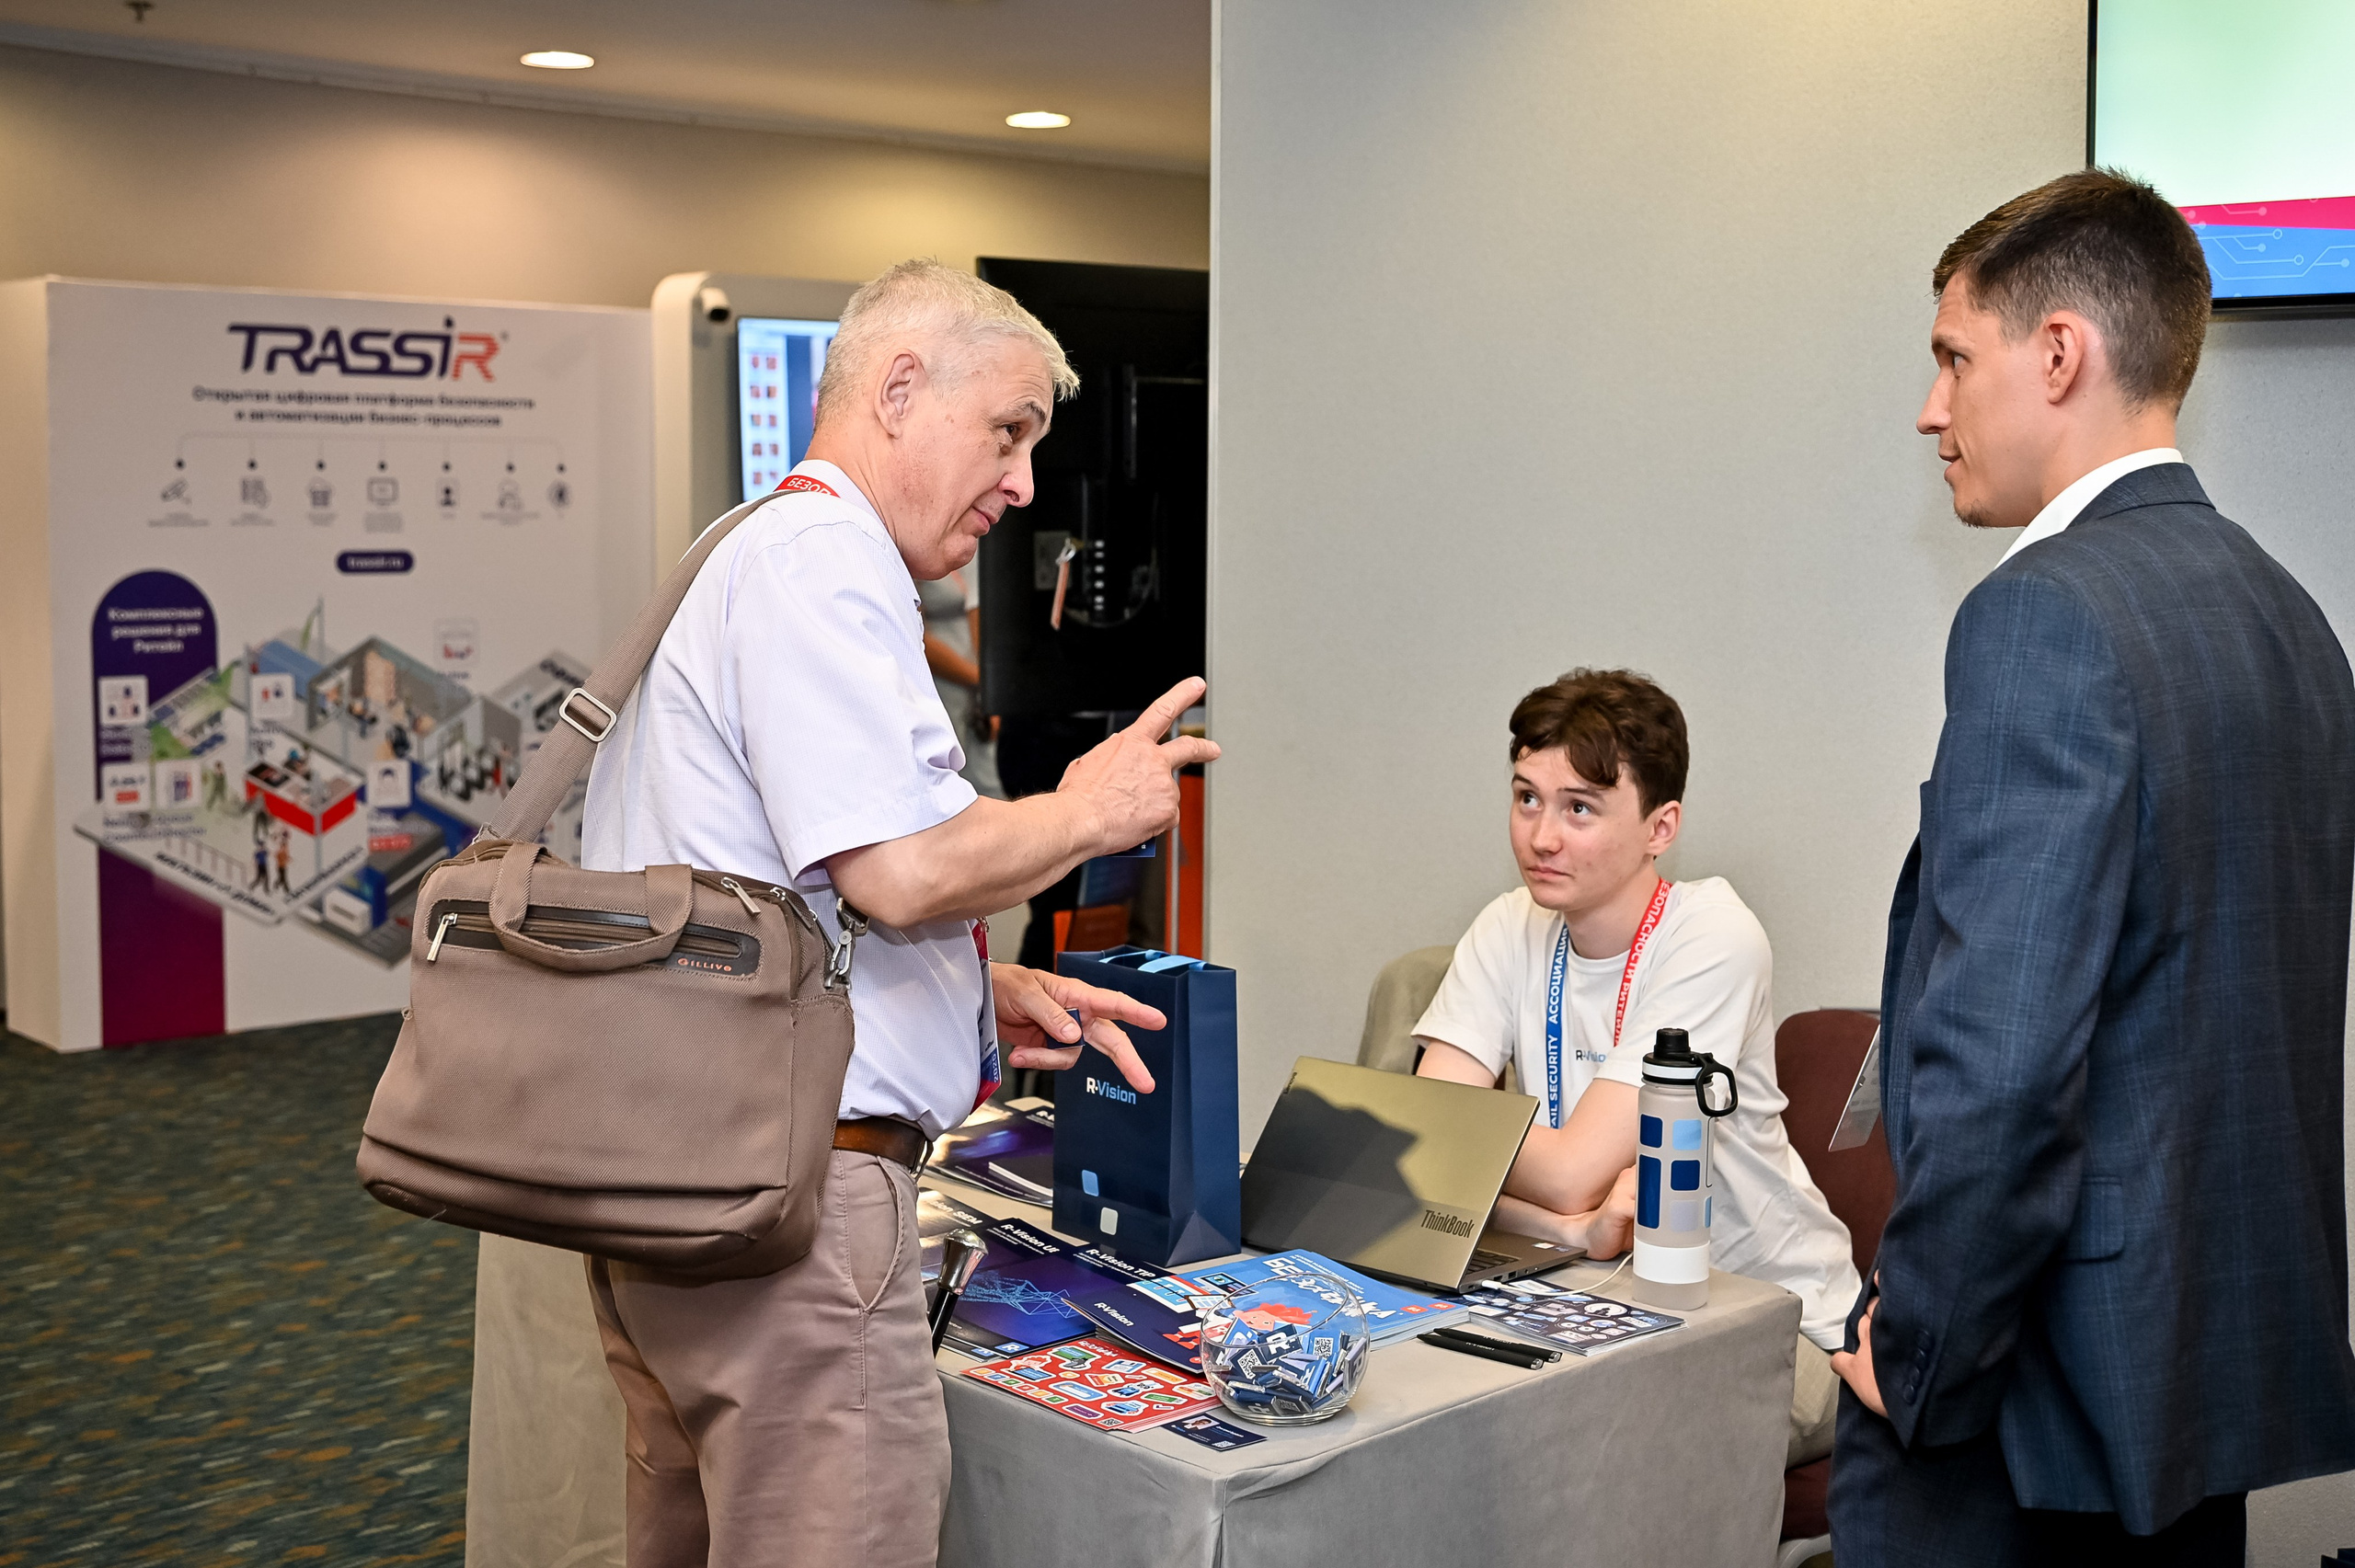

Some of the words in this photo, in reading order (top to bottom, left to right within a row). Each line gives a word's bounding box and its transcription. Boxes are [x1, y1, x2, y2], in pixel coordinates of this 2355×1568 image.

[1547, 1034, 1558, 1102] SECURITY
[953, 1210, 983, 1225] SIEM
[1421, 1209, 1475, 1239] ThinkBook
[1000, 1223, 1045, 1247] R-Vision
[1086, 1249, 1135, 1271] R-Vision
[1134, 1268, 1156, 1277] TIP
